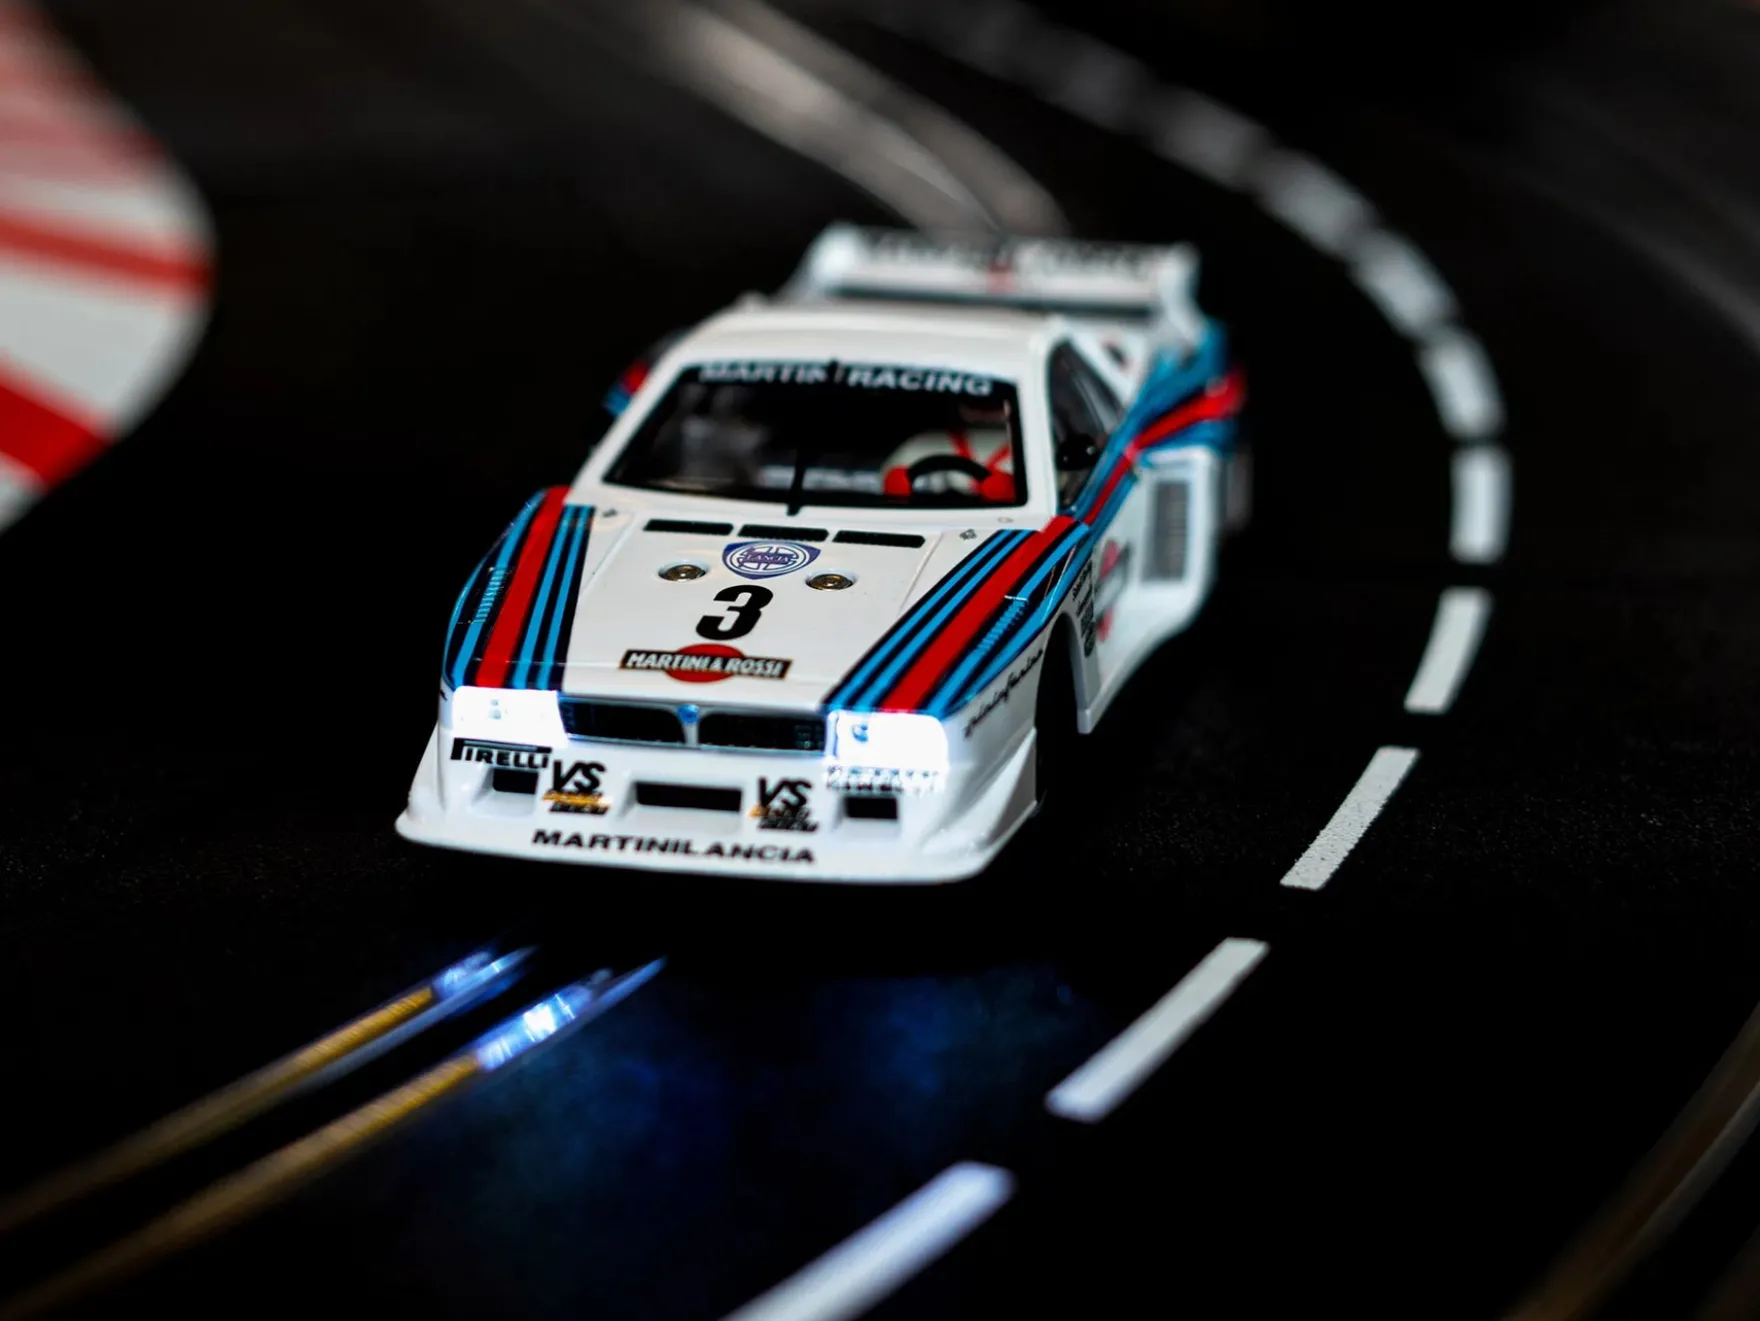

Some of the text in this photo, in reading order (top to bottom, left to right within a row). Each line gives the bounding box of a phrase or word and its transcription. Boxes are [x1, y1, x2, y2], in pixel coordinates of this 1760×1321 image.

[847, 366, 992, 396] RACING
[696, 584, 774, 641] 3
[626, 652, 710, 672] MARTINI
[724, 658, 784, 678] ROSSI
[450, 737, 552, 769] PIRELLI
[553, 760, 606, 793] VS
[759, 776, 812, 810] VS
